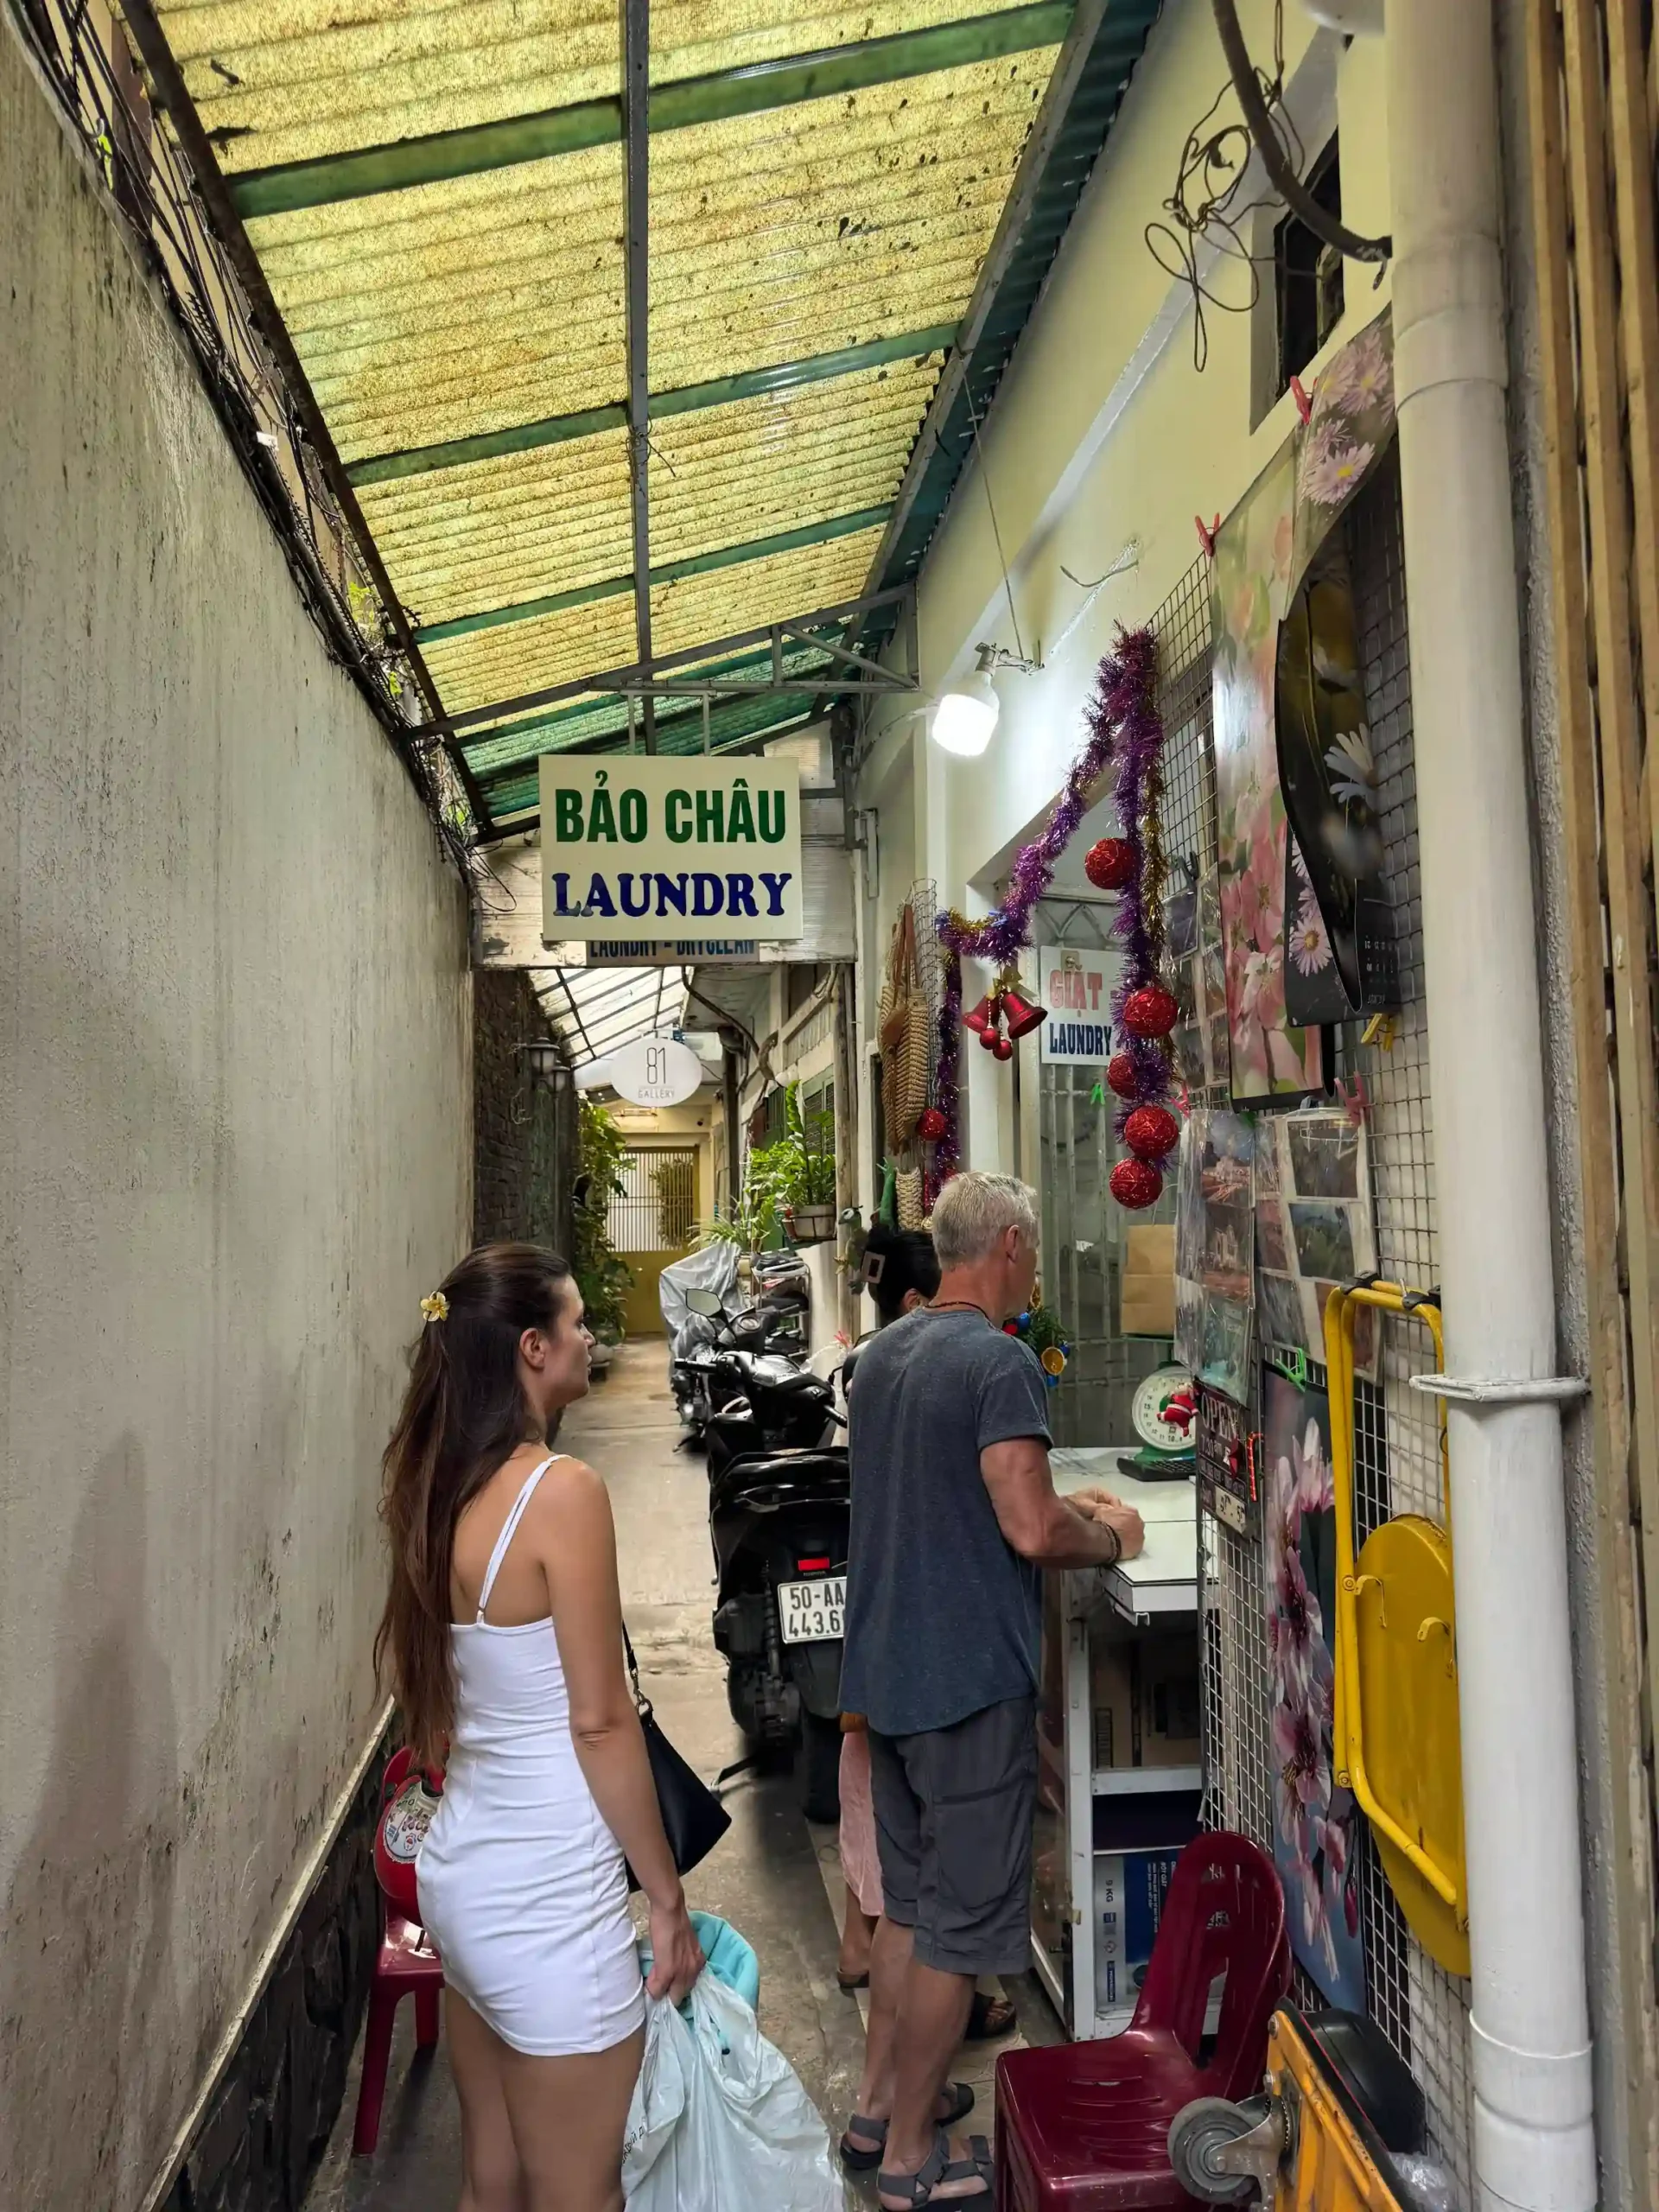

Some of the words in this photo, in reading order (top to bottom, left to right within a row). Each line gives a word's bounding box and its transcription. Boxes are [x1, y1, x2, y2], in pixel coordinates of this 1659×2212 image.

[555, 770, 648, 843] BẢO
[664, 779, 786, 843] CHÂU
[551, 872, 793, 918] LAUNDRY
[589, 940, 658, 958] LAUNDRY
[1049, 1023, 1112, 1056] LAUNDRY
[646, 1047, 666, 1084] 81
[638, 1089, 675, 1099] GALLERY
[1201, 1391, 1238, 1442] OPEN
[789, 1582, 844, 1610] 50-AA
[789, 1610, 844, 1637] 443.6
[1106, 1888, 1113, 1903] KG
